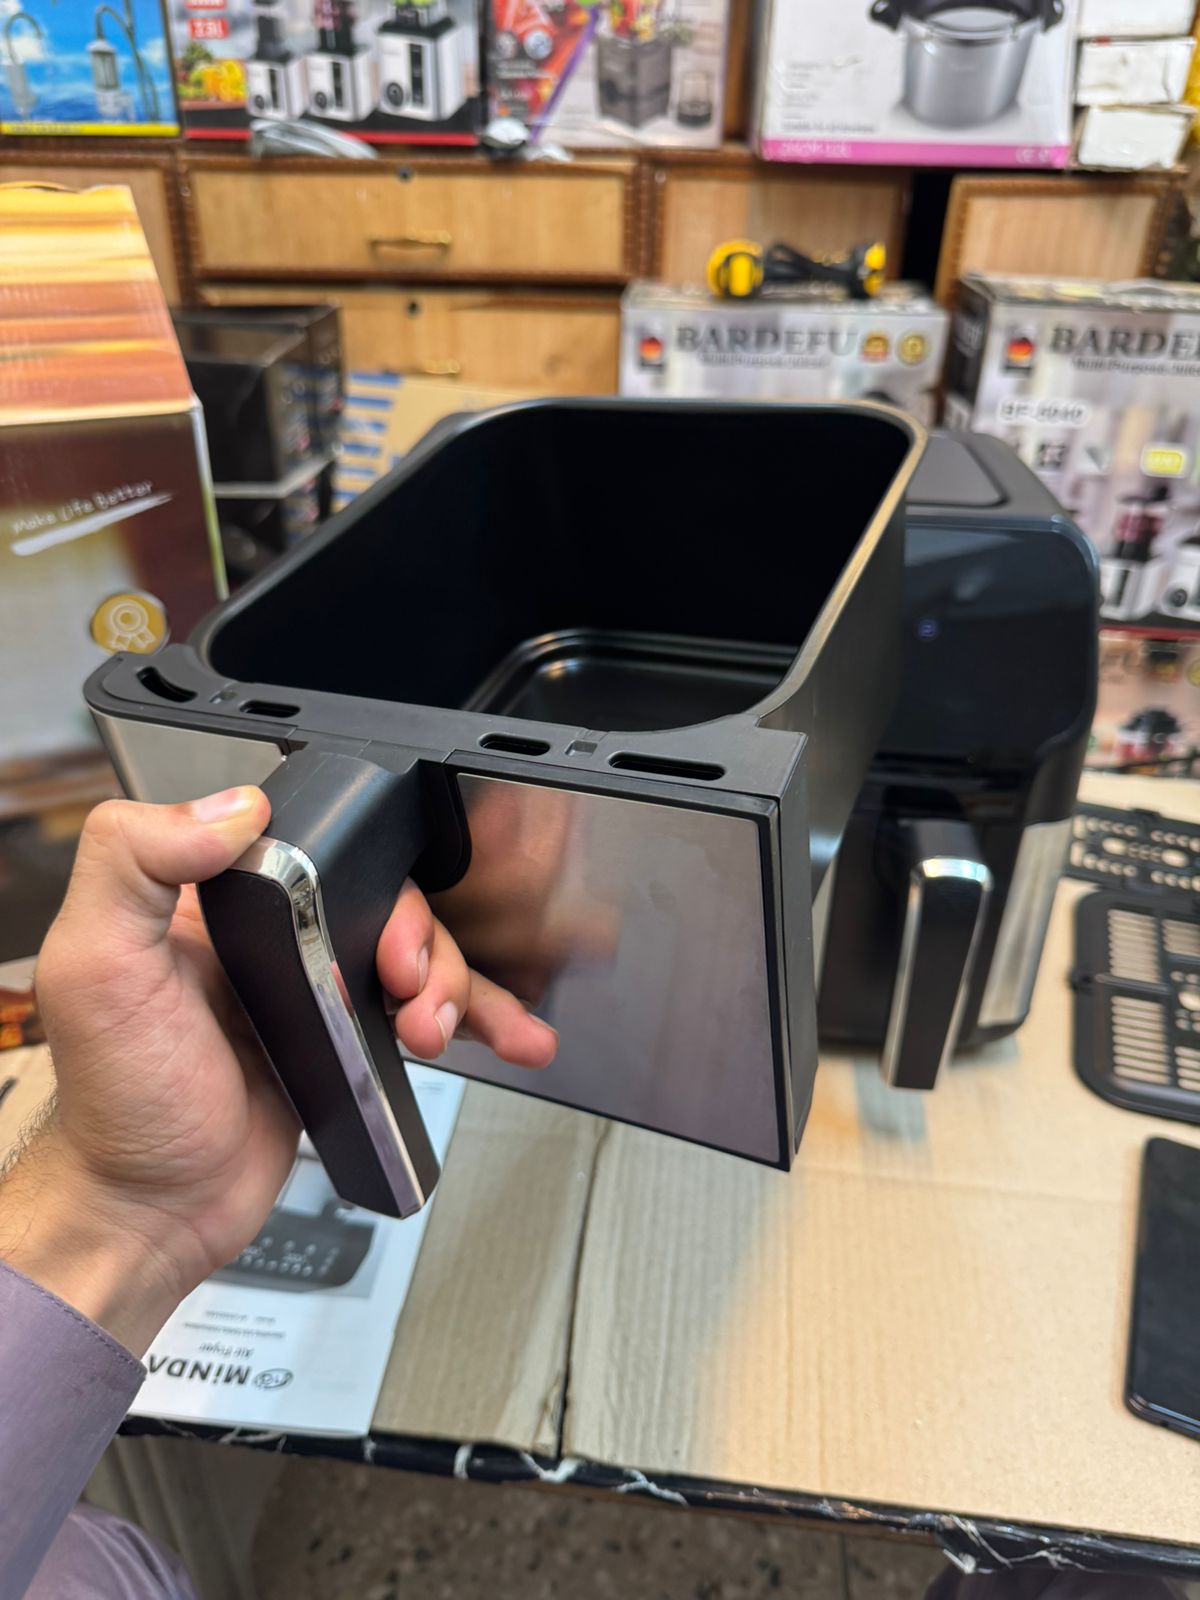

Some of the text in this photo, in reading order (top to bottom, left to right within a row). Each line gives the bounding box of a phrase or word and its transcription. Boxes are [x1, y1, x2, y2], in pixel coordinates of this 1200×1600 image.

[676, 327, 859, 356] BARDEFU
[12, 481, 152, 533] Make Life Better
